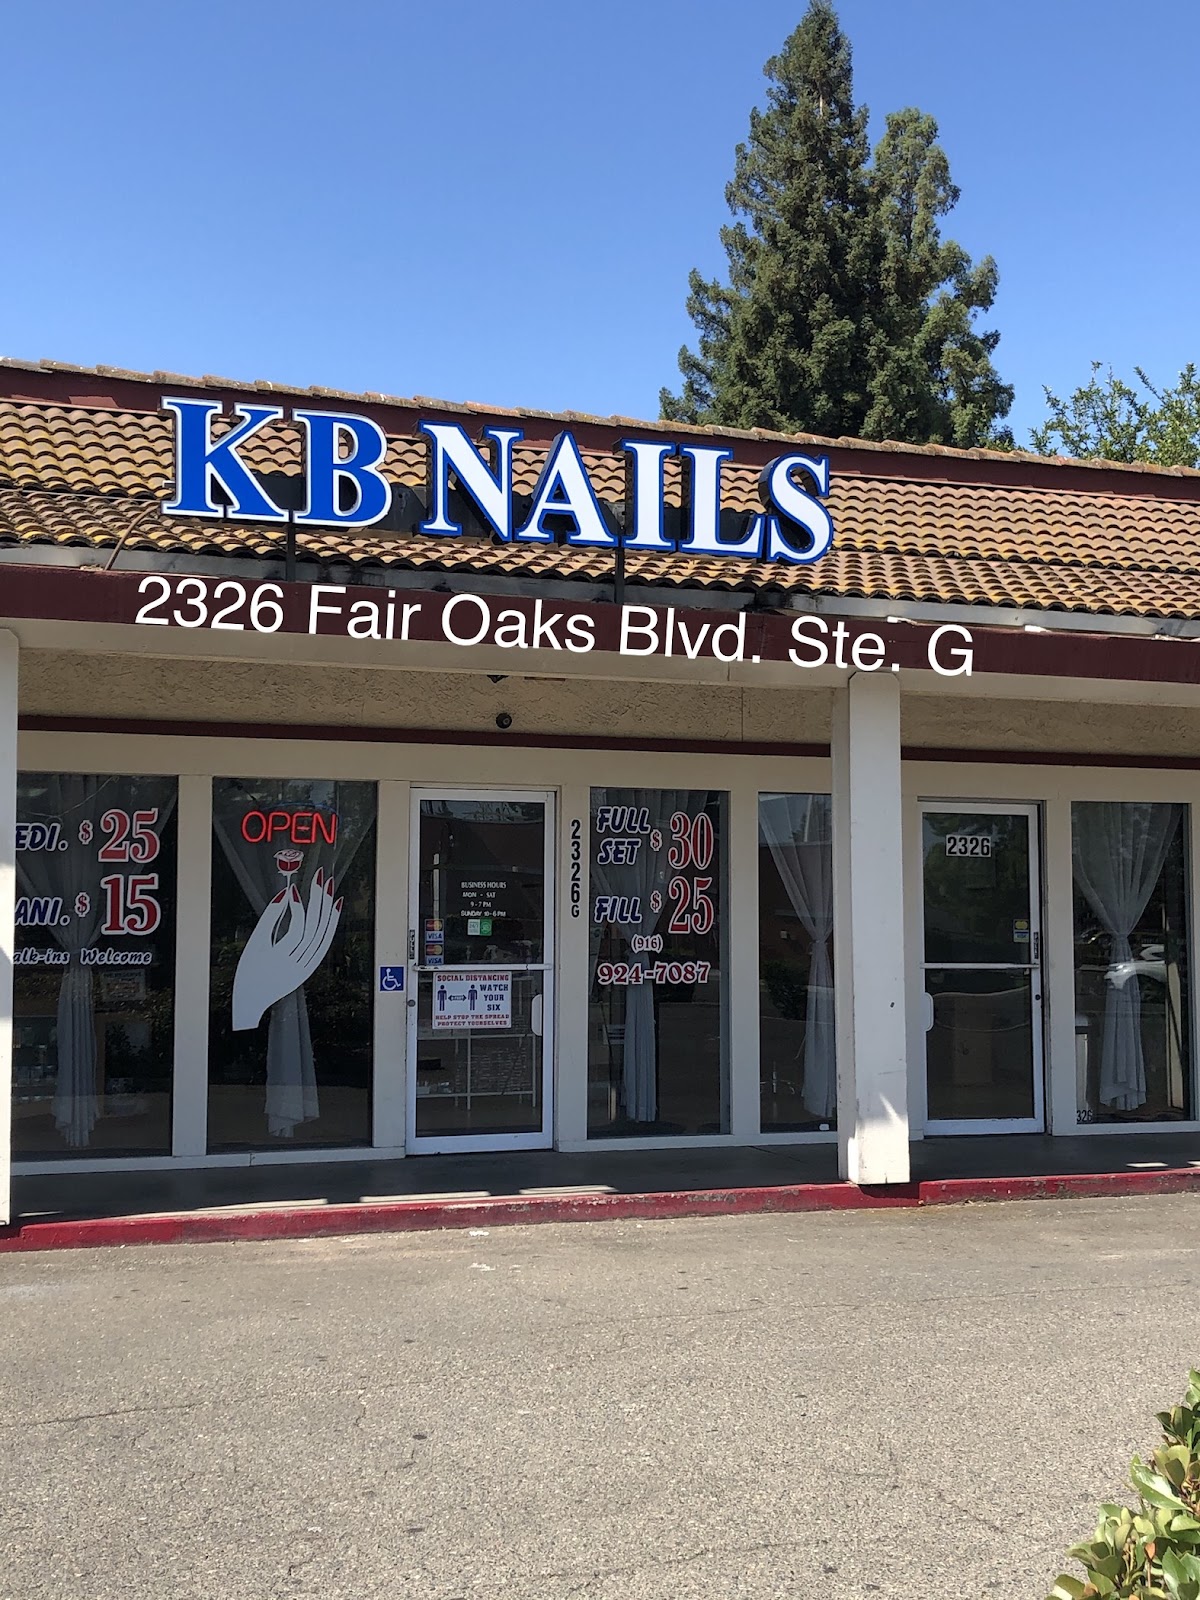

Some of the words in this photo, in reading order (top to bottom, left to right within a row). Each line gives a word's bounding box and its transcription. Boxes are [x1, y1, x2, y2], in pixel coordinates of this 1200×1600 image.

[161, 396, 392, 527] KB
[418, 420, 834, 564] NAILS
[240, 810, 337, 844] OPEN
[596, 806, 650, 834] FULL
[16, 823, 68, 851] EDI.
[947, 836, 991, 857] 2326
[597, 838, 641, 865] SET
[461, 881, 486, 889] BUSINESS
[487, 881, 507, 889] HOURS
[15, 897, 70, 926] ANI.
[594, 896, 642, 923] FILL
[13, 947, 70, 965] alk-ins
[80, 948, 153, 966] Welcome
[631, 934, 663, 953] (916)
[598, 961, 711, 985] 924-7087
